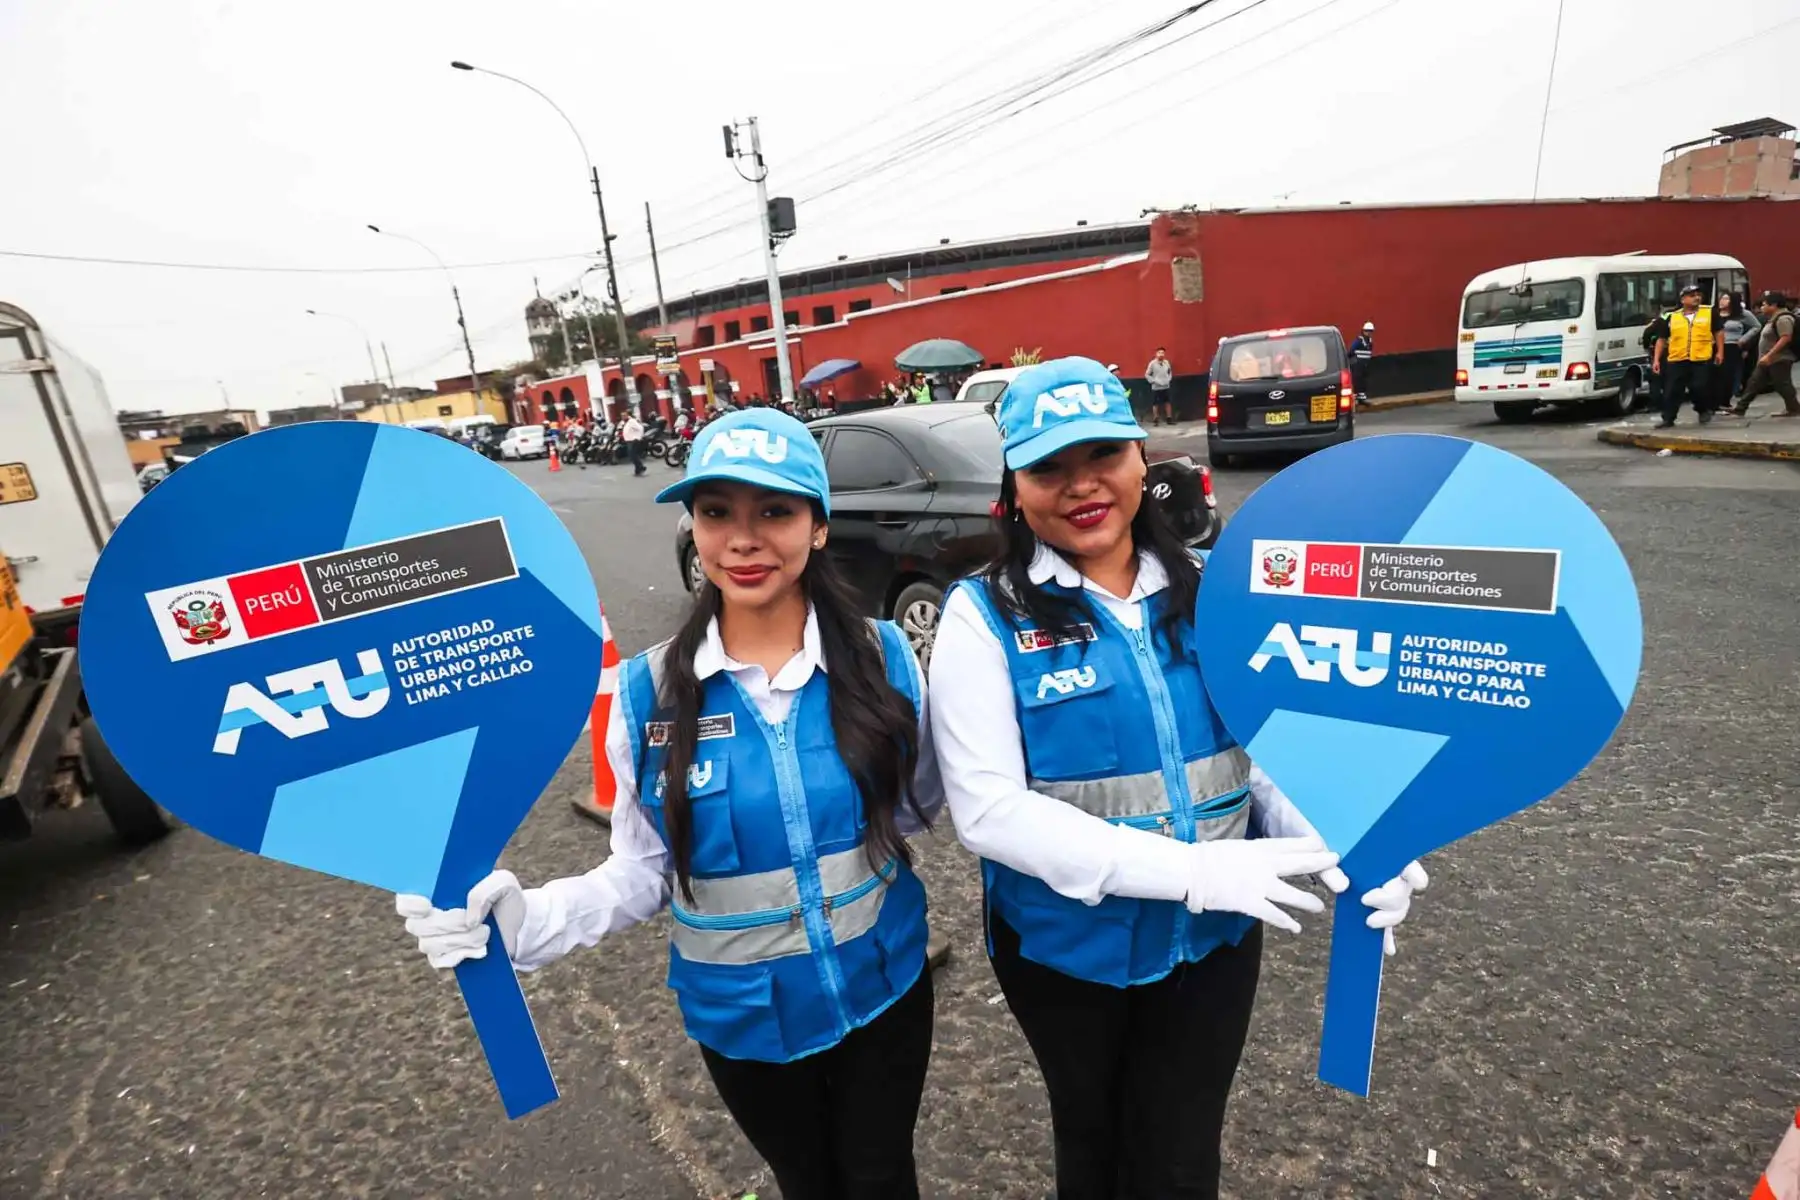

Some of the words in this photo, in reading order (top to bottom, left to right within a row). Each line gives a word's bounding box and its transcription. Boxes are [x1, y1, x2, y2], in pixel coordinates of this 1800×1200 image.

[1032, 383, 1109, 428] ATU
[701, 429, 788, 466] ATU
[316, 551, 399, 579] Ministerio
[322, 580, 343, 594] de
[345, 558, 439, 588] Transportes
[1310, 561, 1353, 578] PERÚ
[1370, 566, 1387, 578] de
[1391, 567, 1477, 583] Transportes
[1371, 552, 1444, 567] Ministerio
[245, 584, 302, 615] PERÚ
[327, 598, 336, 611] y
[341, 566, 468, 605] Comunicaciones
[1369, 581, 1377, 593] y
[1380, 580, 1502, 598] Comunicaciones
[392, 618, 495, 656] AUTORIDAD
[394, 656, 420, 673] DE
[421, 625, 535, 665] TRANSPORTE
[1402, 634, 1508, 656] AUTORIDAD
[400, 658, 476, 688] URBANO
[478, 646, 524, 667] PARA
[1248, 622, 1392, 687] ATU
[1400, 650, 1422, 663] DE
[1425, 652, 1547, 677] TRANSPORTE
[405, 683, 450, 705] LIMA
[451, 678, 462, 691] Y
[467, 660, 533, 687] CALLAO
[1036, 665, 1097, 699] ATU
[1397, 680, 1438, 697] LIMA
[1442, 687, 1453, 699] Y
[1456, 688, 1531, 709] CALLAO
[1399, 665, 1472, 685] URBANO
[1476, 674, 1525, 692] PARA
[212, 648, 391, 756] ATU
